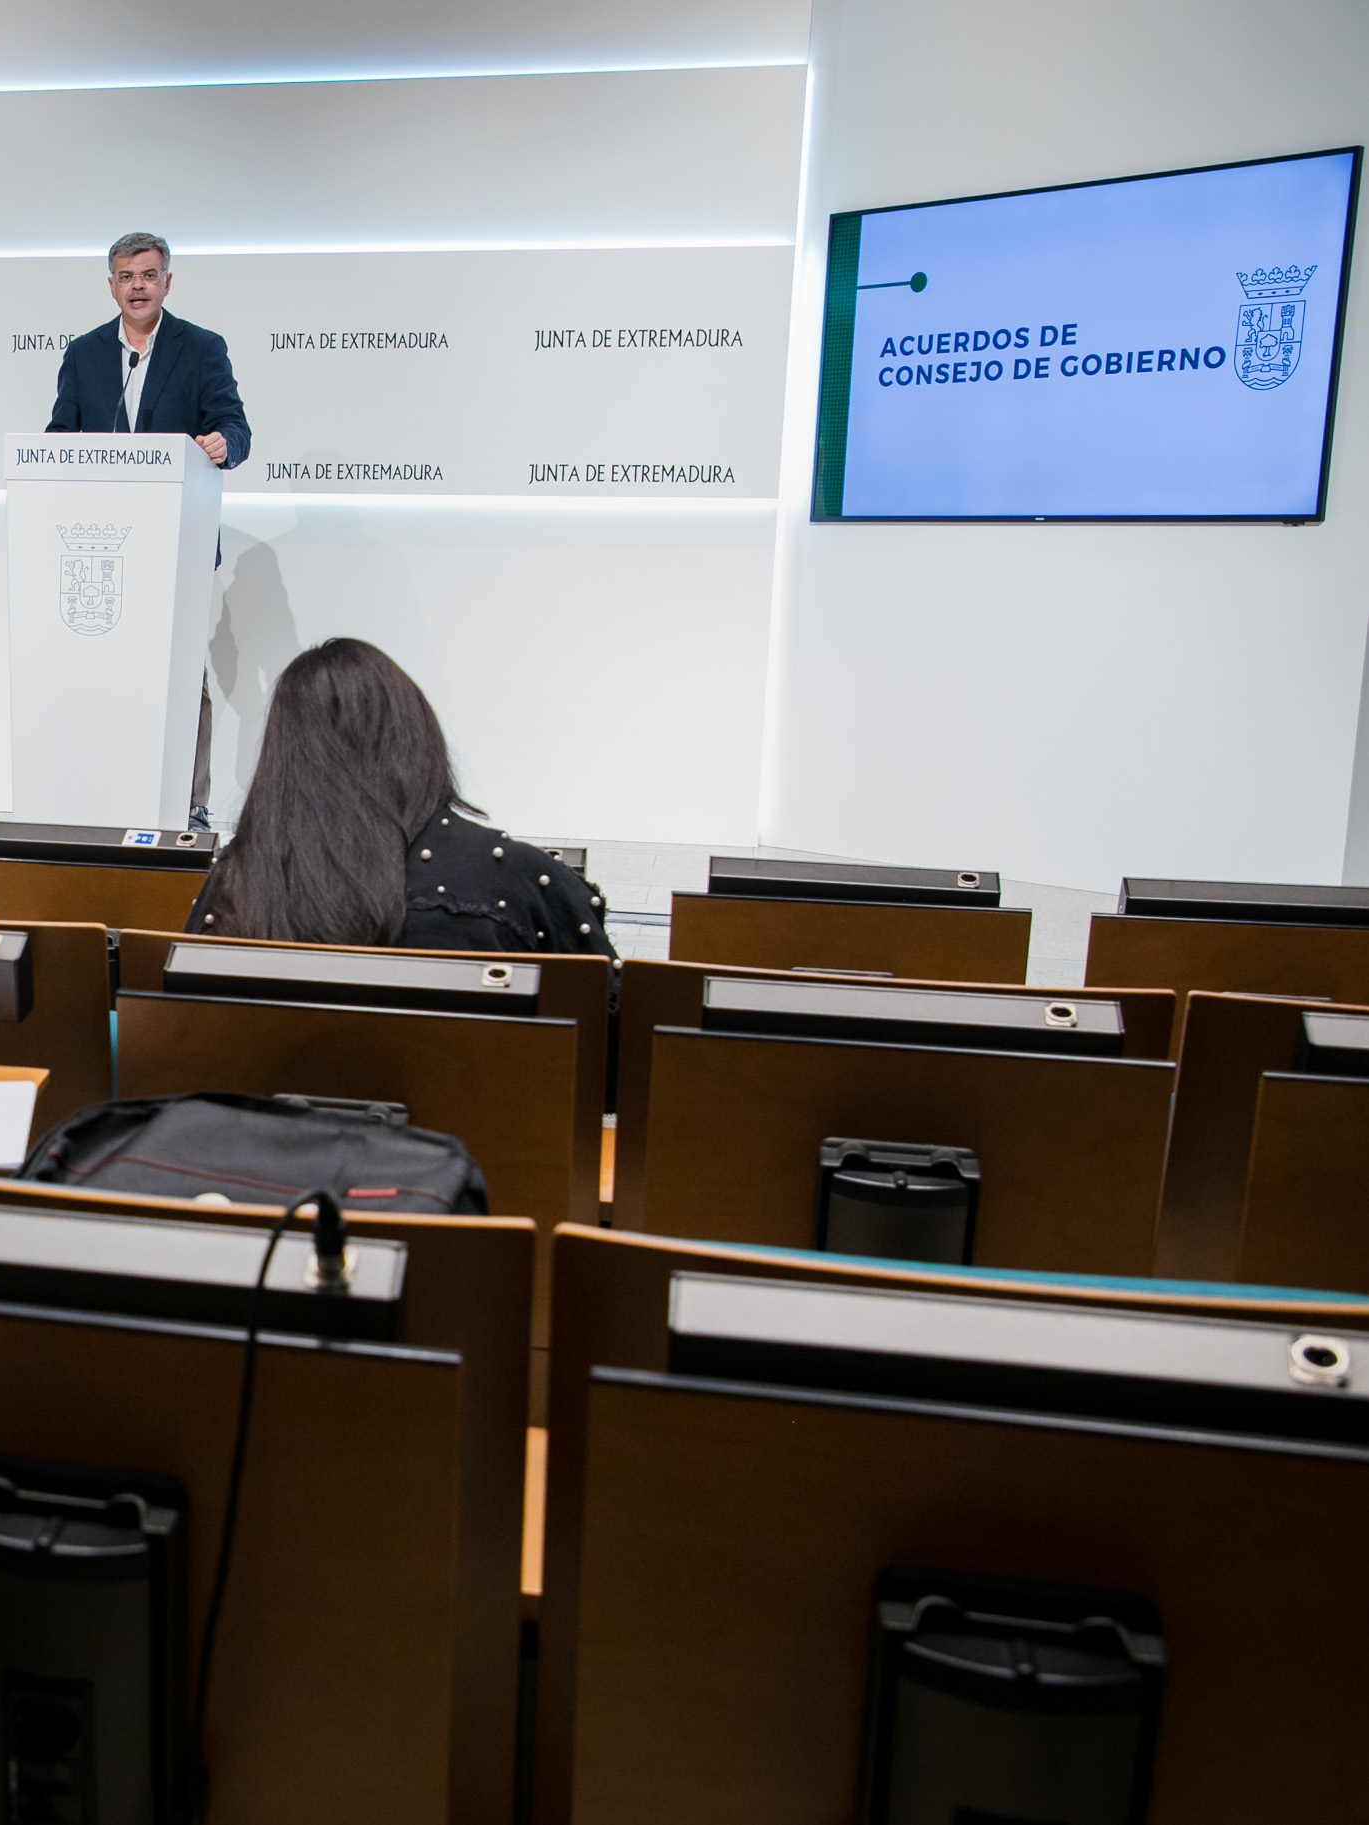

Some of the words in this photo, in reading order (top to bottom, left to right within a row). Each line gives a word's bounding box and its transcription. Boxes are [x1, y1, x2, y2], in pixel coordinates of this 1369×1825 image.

[12, 334, 55, 353] JUNTA
[270, 333, 316, 353] JUNTA
[320, 333, 337, 350] DE
[342, 332, 449, 350] EXTREMADURA
[534, 329, 587, 352] JUNTA
[592, 329, 613, 348] DE
[618, 329, 744, 348] EXTREMADURA
[880, 327, 1030, 358] ACUERDOS
[1039, 323, 1078, 347] DE
[878, 360, 1003, 388] CONSEJO
[1013, 357, 1050, 379] DE
[1060, 346, 1226, 377] GOBIERNO
[16, 448, 56, 466] JUNTA
[60, 449, 75, 464] DE
[79, 449, 172, 465] EXTREMADURA
[266, 462, 311, 482] JUNTA
[315, 463, 332, 480] DE
[337, 463, 444, 481] EXTREMADURA
[528, 463, 581, 485] JUNTA
[586, 464, 606, 483] DE
[611, 464, 736, 484] EXTREMADURA
